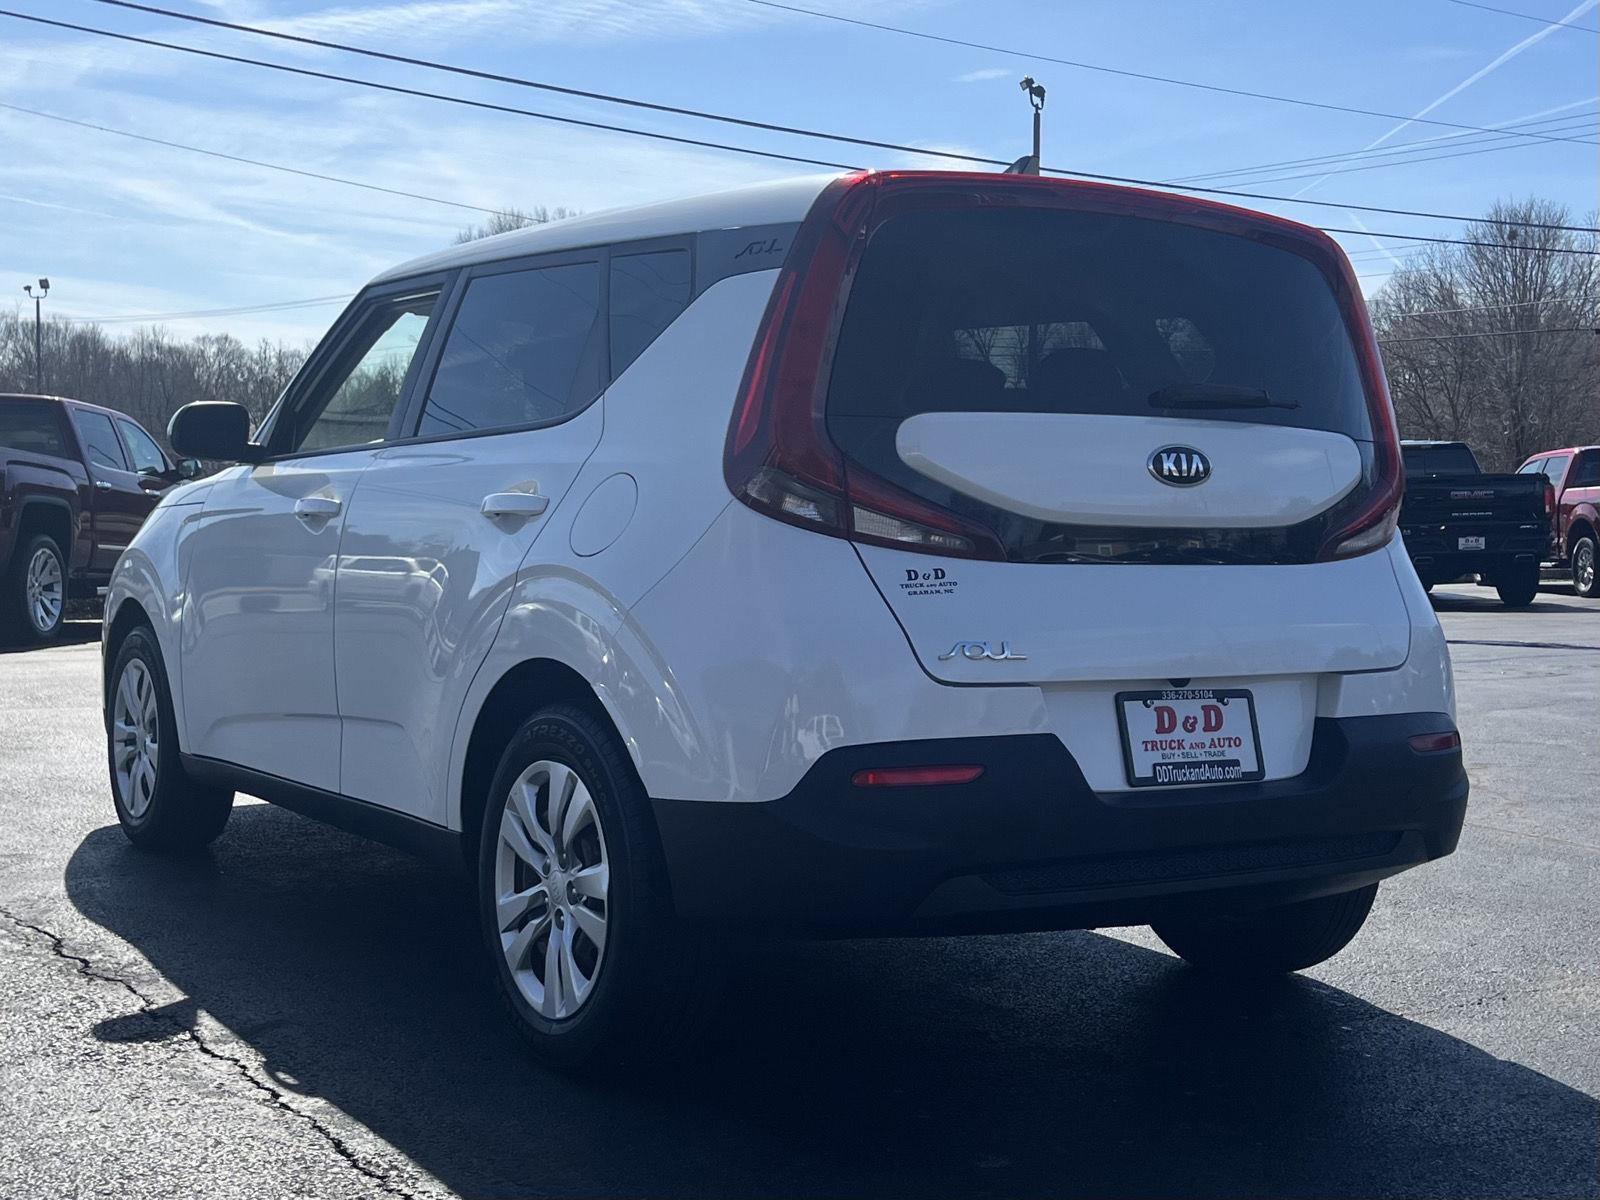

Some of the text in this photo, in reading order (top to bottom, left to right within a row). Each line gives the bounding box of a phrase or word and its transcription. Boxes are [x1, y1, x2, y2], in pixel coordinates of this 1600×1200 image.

[1160, 453, 1205, 477] KIA
[906, 569, 919, 581] D
[933, 568, 945, 580] D
[938, 640, 1028, 660] SOUL
[1161, 690, 1213, 700] 336-270-5104
[1154, 705, 1223, 734] D & D
[1142, 739, 1186, 752] TRUCK
[1208, 737, 1242, 749] AUTO
[1204, 750, 1226, 758] TRADE
[1155, 763, 1242, 782] DDTruckandAuto.com
